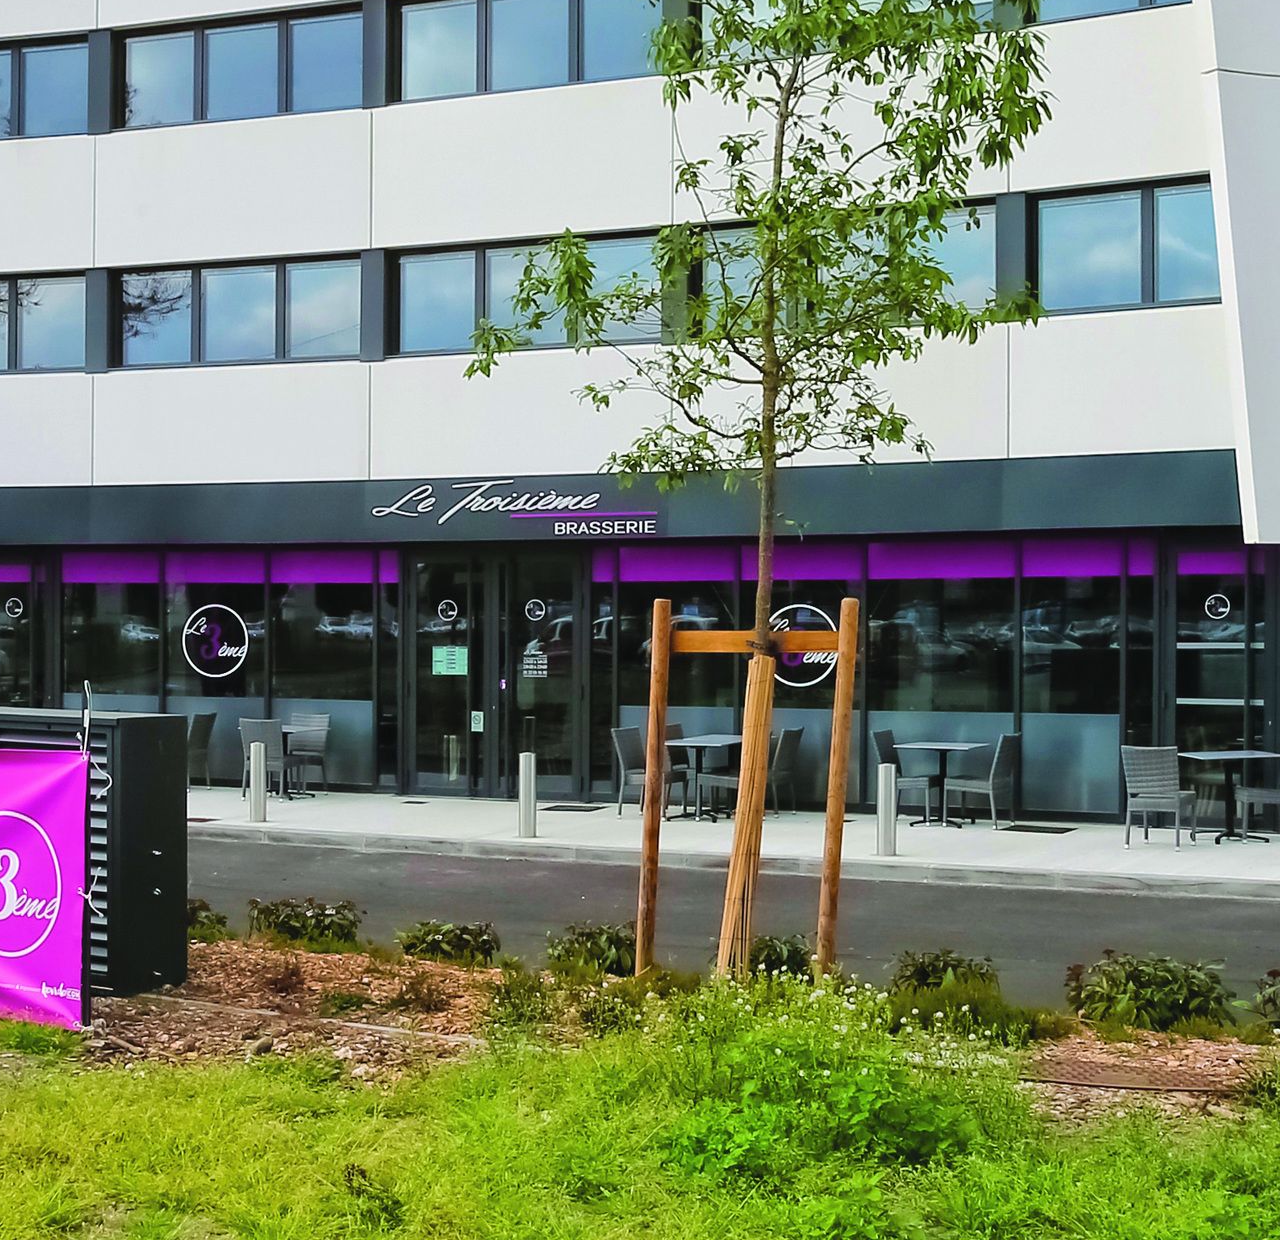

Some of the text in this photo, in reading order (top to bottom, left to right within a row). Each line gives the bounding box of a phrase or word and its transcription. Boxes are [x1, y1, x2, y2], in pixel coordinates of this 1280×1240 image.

[372, 479, 601, 525] Le Troisième
[554, 520, 657, 535] BRASSERIE
[185, 617, 208, 635] Le
